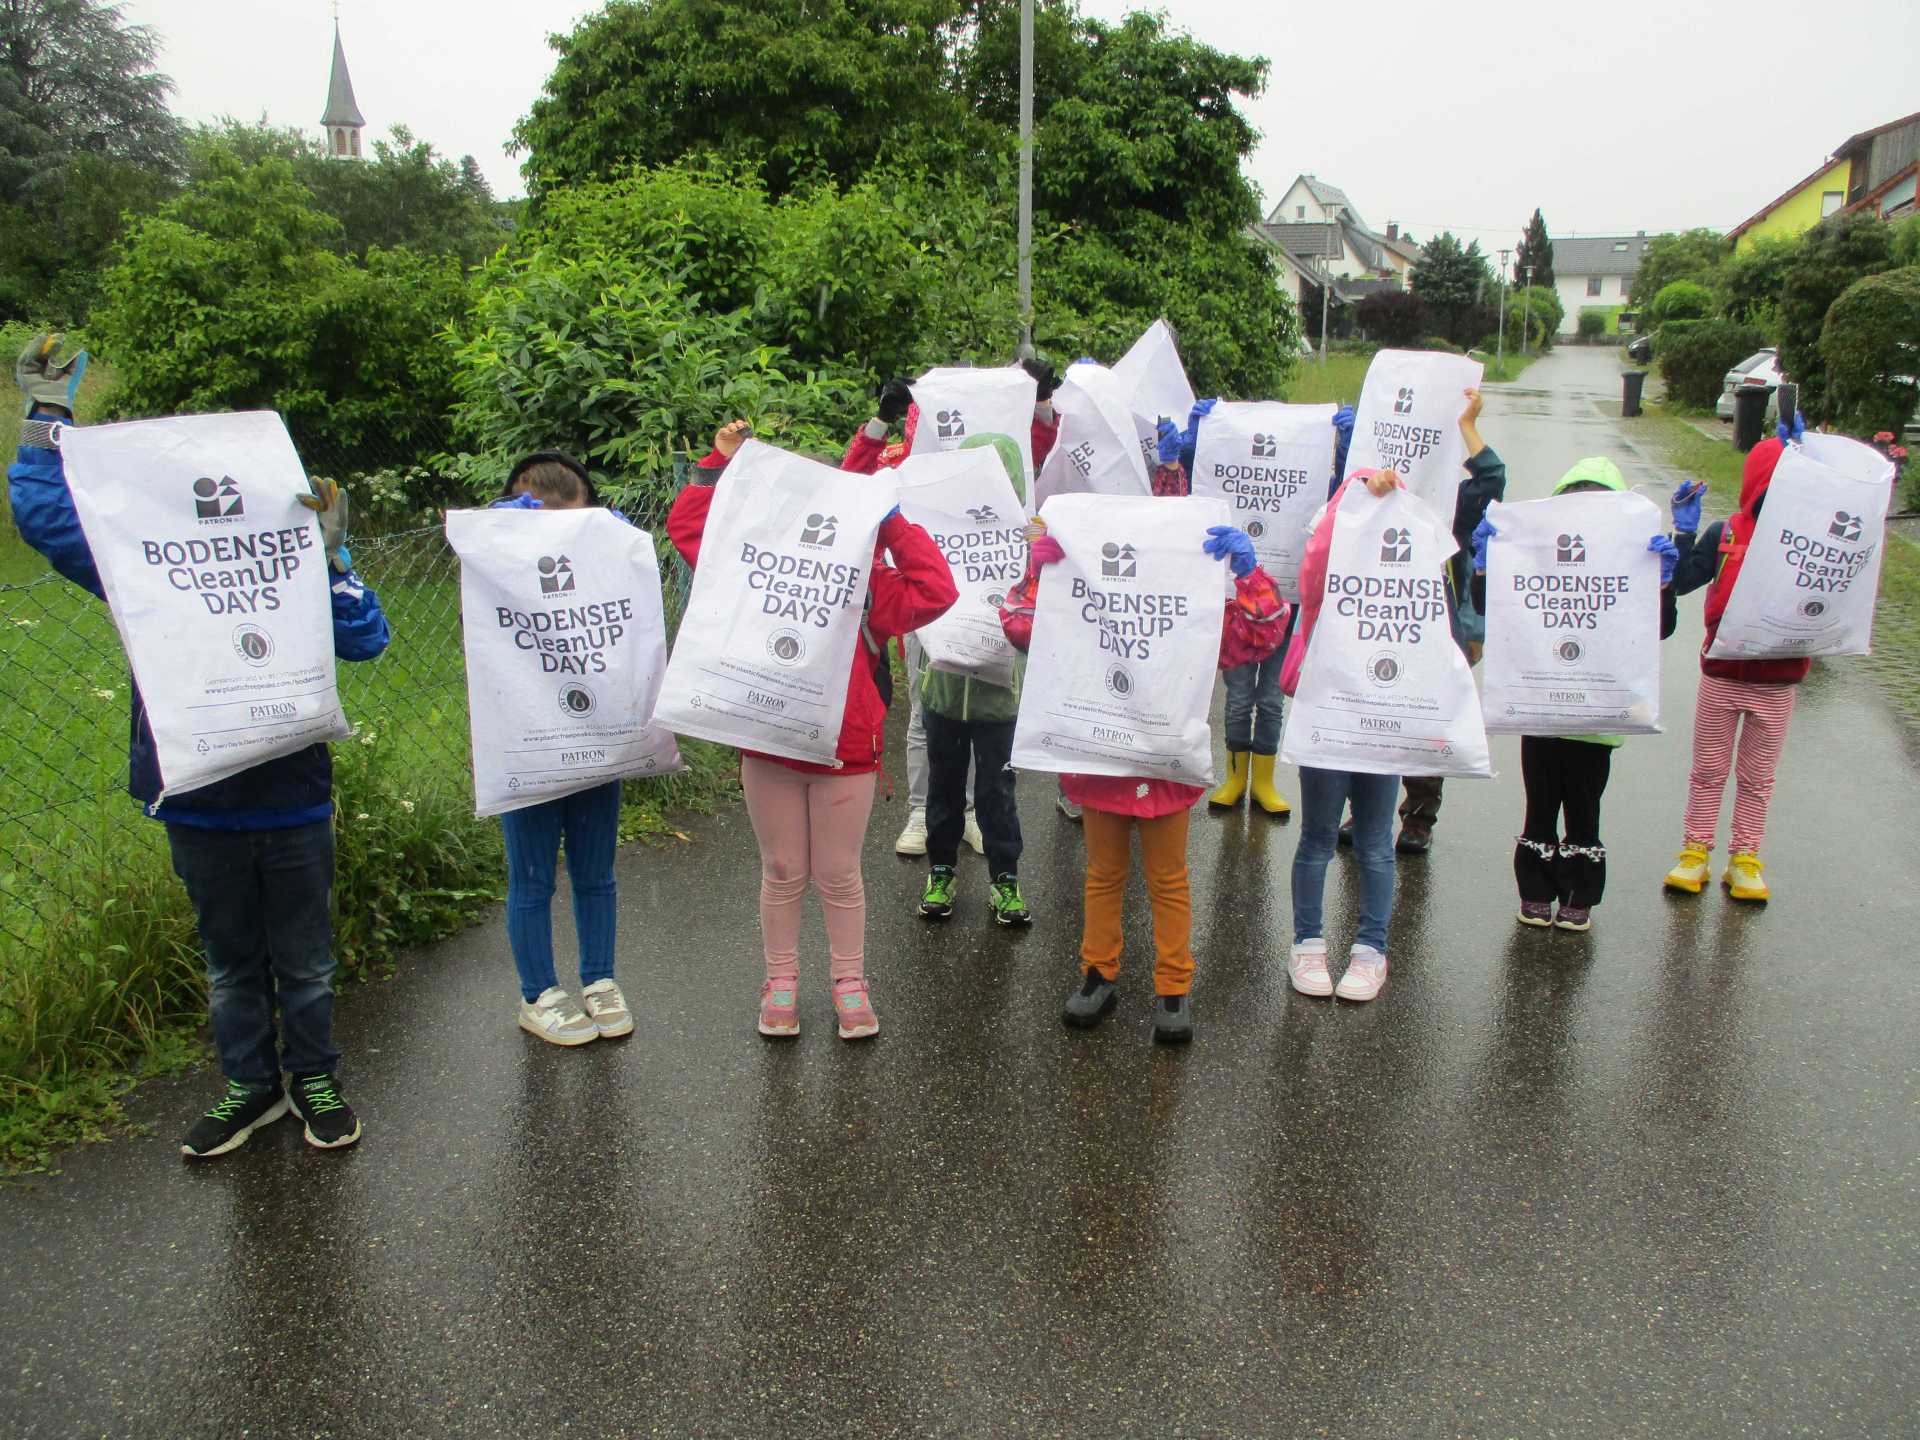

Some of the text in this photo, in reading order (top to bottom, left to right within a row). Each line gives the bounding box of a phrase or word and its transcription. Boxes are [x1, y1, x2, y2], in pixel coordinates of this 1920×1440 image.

[1377, 438, 1431, 460] CleanUP
[1214, 463, 1308, 485] BODENSEE
[1222, 479, 1297, 498] CleanUP
[1236, 495, 1281, 513] DAYS
[142, 525, 313, 567] BODENSEE
[934, 527, 1025, 550] BODENS
[1780, 529, 1876, 565] BODENSE
[946, 544, 1026, 565] CleanU
[1785, 550, 1868, 579] CleanU
[168, 555, 300, 591] CleanUP
[740, 542, 860, 590] BODENSE
[965, 562, 1021, 582] DAYS
[1328, 573, 1444, 601] BODENSE
[1513, 575, 1629, 594] BODENSEE
[1795, 572, 1852, 593] DAYS
[200, 586, 281, 615] DAYS
[763, 594, 831, 628] DAYS
[1336, 597, 1444, 622] CleanUP
[1524, 593, 1617, 611] CleanUP
[496, 598, 633, 633] BODENSEE
[1543, 612, 1597, 629] DAYS
[514, 625, 625, 653] CleanUP
[1357, 621, 1421, 644] DAYS
[1099, 629, 1150, 661] DAYS
[540, 651, 607, 675] DAYS
[250, 701, 297, 718] PATRON
[747, 690, 786, 709] PATRON
[1360, 717, 1402, 729] PATRON
[1092, 726, 1135, 744] PATRON
[561, 749, 606, 762] PATRON
